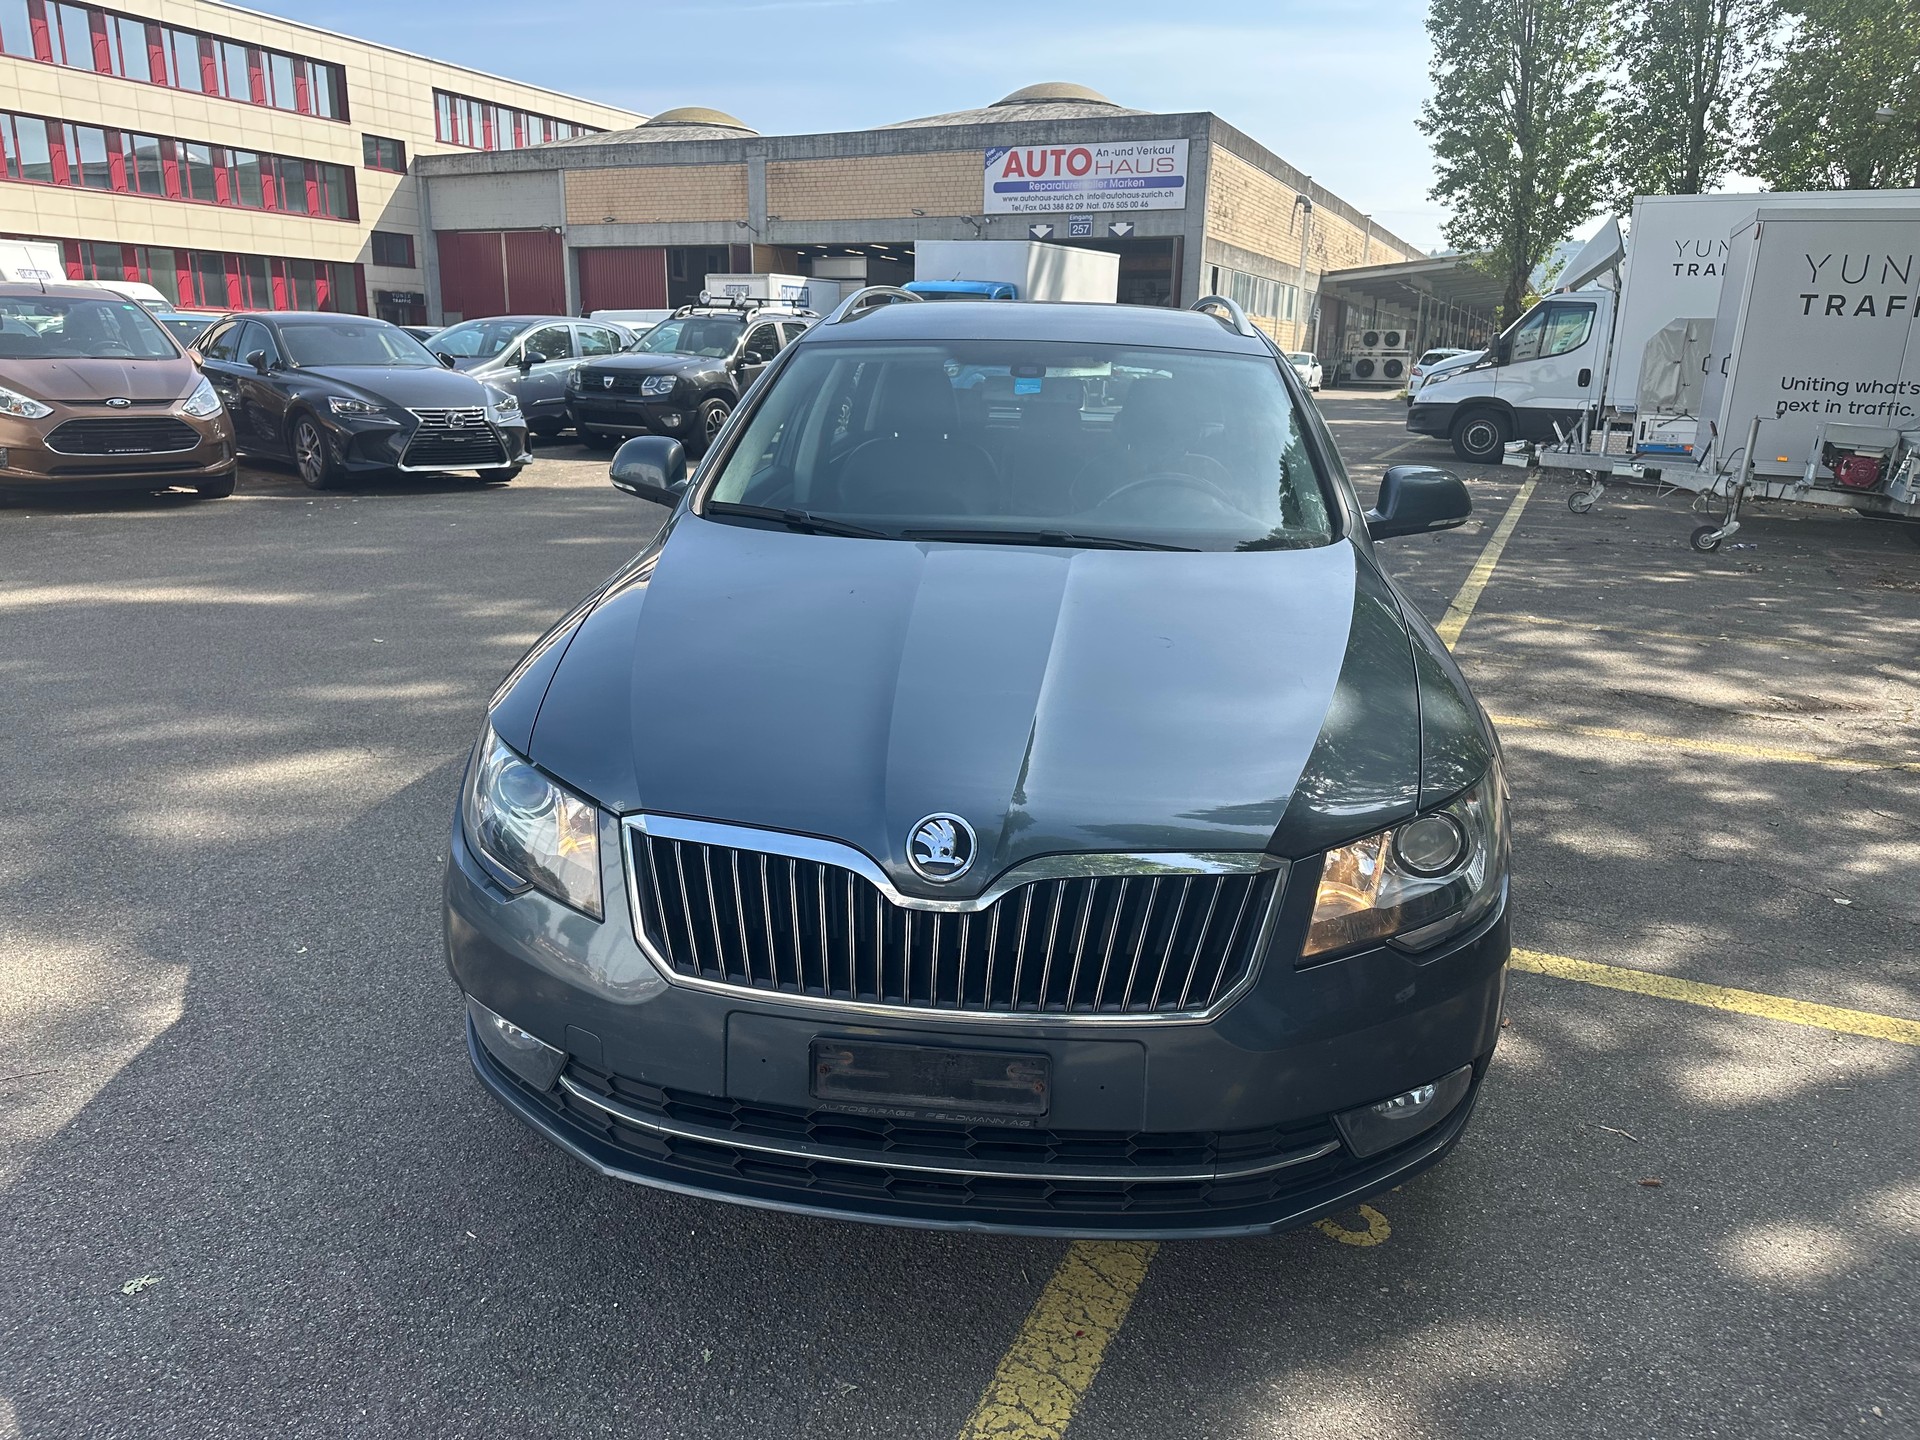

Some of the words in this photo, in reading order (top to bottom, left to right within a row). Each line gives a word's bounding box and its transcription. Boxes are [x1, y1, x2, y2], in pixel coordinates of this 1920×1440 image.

[1096, 148, 1109, 157] An
[1136, 145, 1175, 155] Verkauf
[1002, 148, 1093, 178] AUTO
[1095, 157, 1175, 176] HAUS
[1029, 180, 1083, 191] Reparature
[1109, 178, 1145, 188] Marken
[1002, 193, 1084, 202] www.autohaus-zurich.ch
[1087, 190, 1174, 200] info@autohaus-zurich.ch
[1052, 202, 1065, 210] 388
[1065, 202, 1074, 210] 82
[1075, 202, 1084, 210] 09
[1102, 201, 1115, 209] 076
[1129, 200, 1139, 208] 00
[1140, 200, 1149, 208] 46
[1069, 214, 1093, 222] Eingang
[1072, 224, 1090, 234] 257
[1672, 263, 1726, 276] TRA
[1805, 253, 1913, 285] YUN
[1781, 376, 1849, 396] Uniting
[1855, 380, 1920, 395] what's
[1776, 399, 1820, 413] next
[1824, 399, 1842, 413] in
[1847, 400, 1915, 417] traffic.
[818, 1103, 917, 1118] AUTOGARAGE
